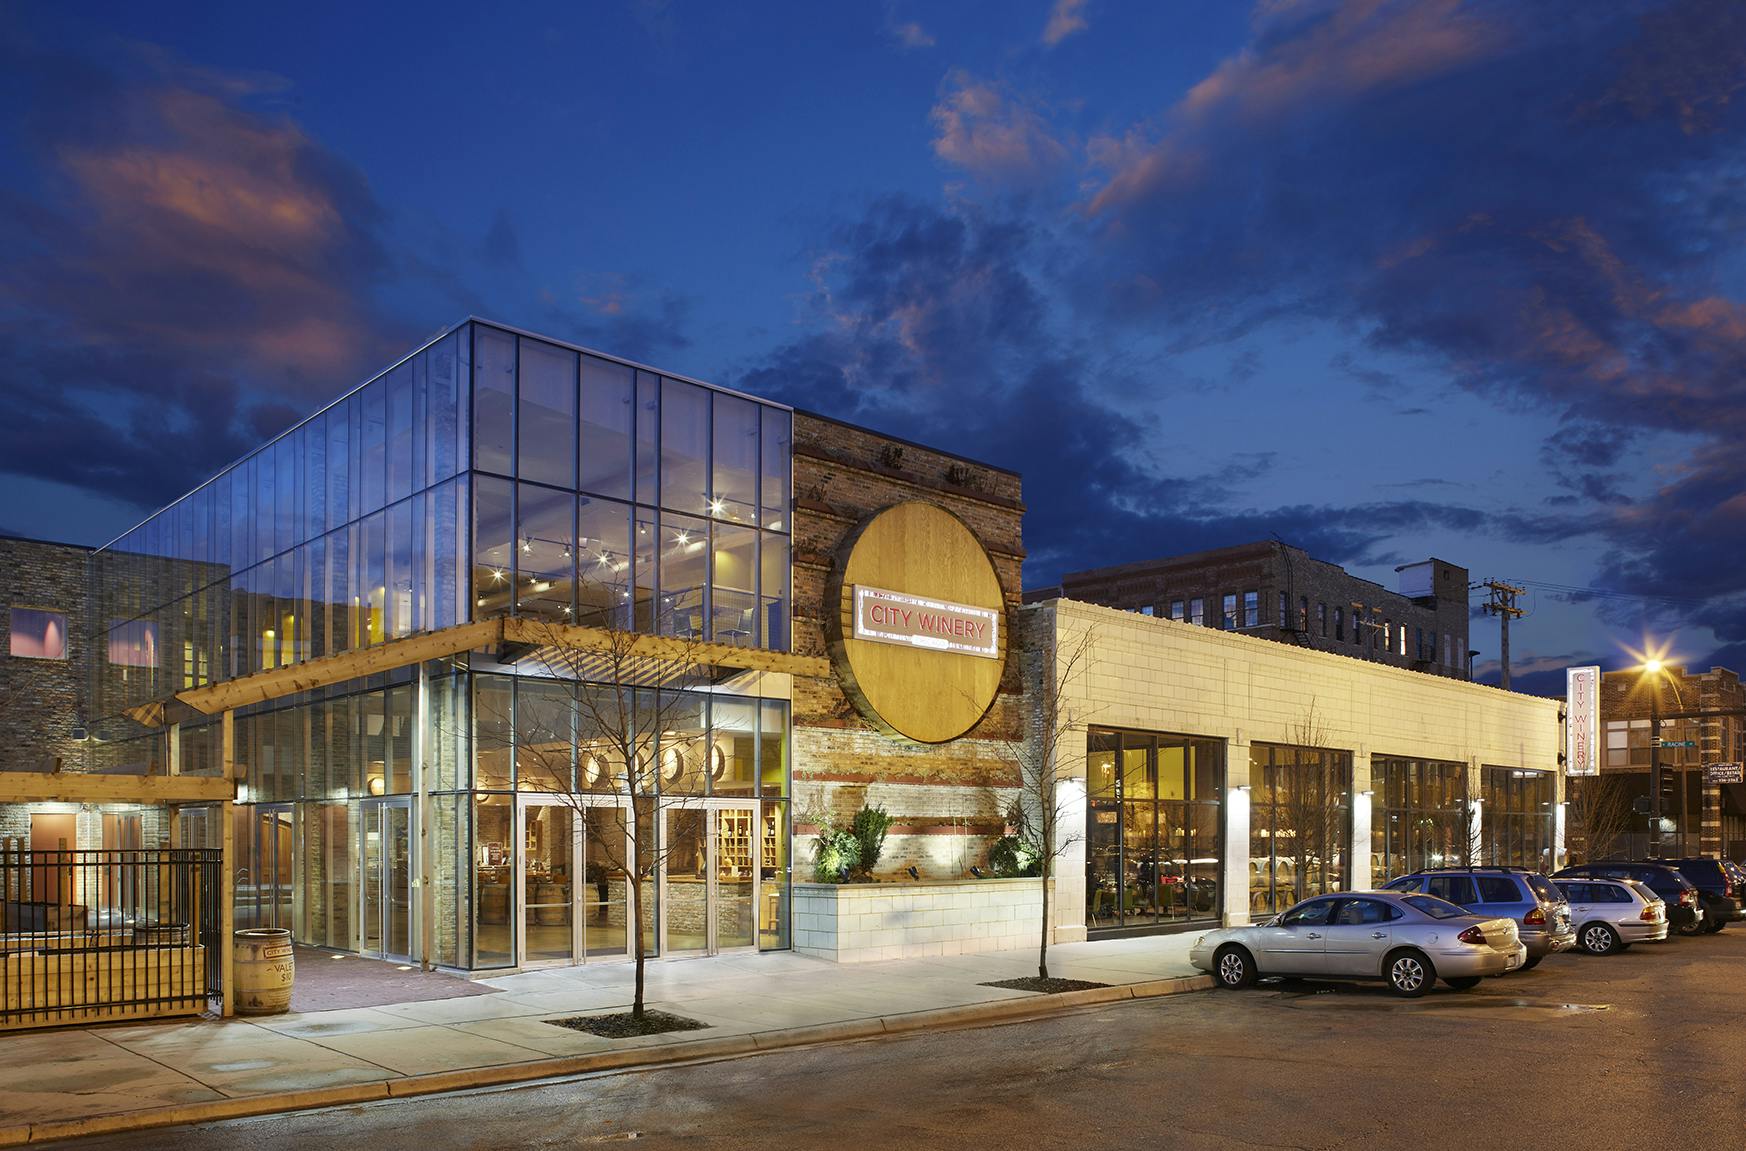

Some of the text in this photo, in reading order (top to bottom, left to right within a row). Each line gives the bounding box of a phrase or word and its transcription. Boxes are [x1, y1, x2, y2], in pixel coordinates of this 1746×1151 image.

[870, 604, 985, 639] CITY WINERY
[1574, 673, 1588, 769] CITY WINERY
